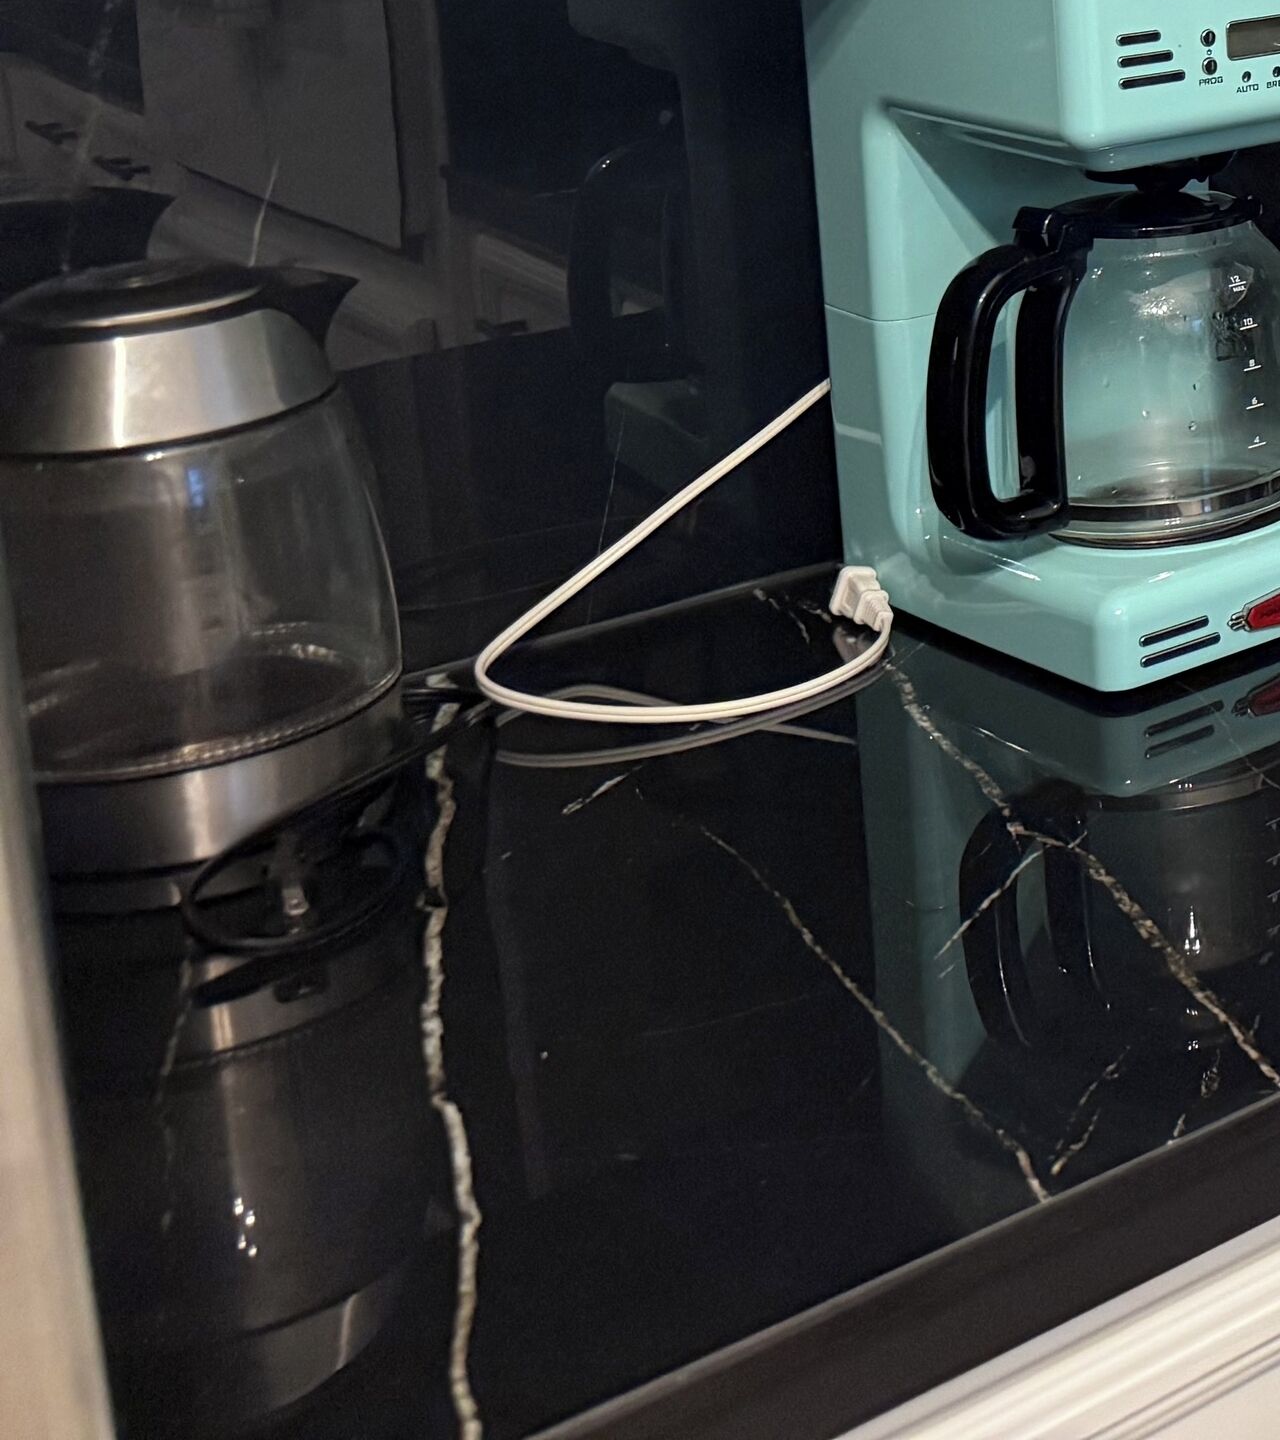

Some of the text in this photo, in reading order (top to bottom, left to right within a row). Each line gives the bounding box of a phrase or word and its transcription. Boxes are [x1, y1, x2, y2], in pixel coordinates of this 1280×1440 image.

[1198, 76, 1224, 86] PROG
[1236, 83, 1259, 93] AUTO
[1229, 275, 1241, 283] 12
[1242, 317, 1253, 326] 10
